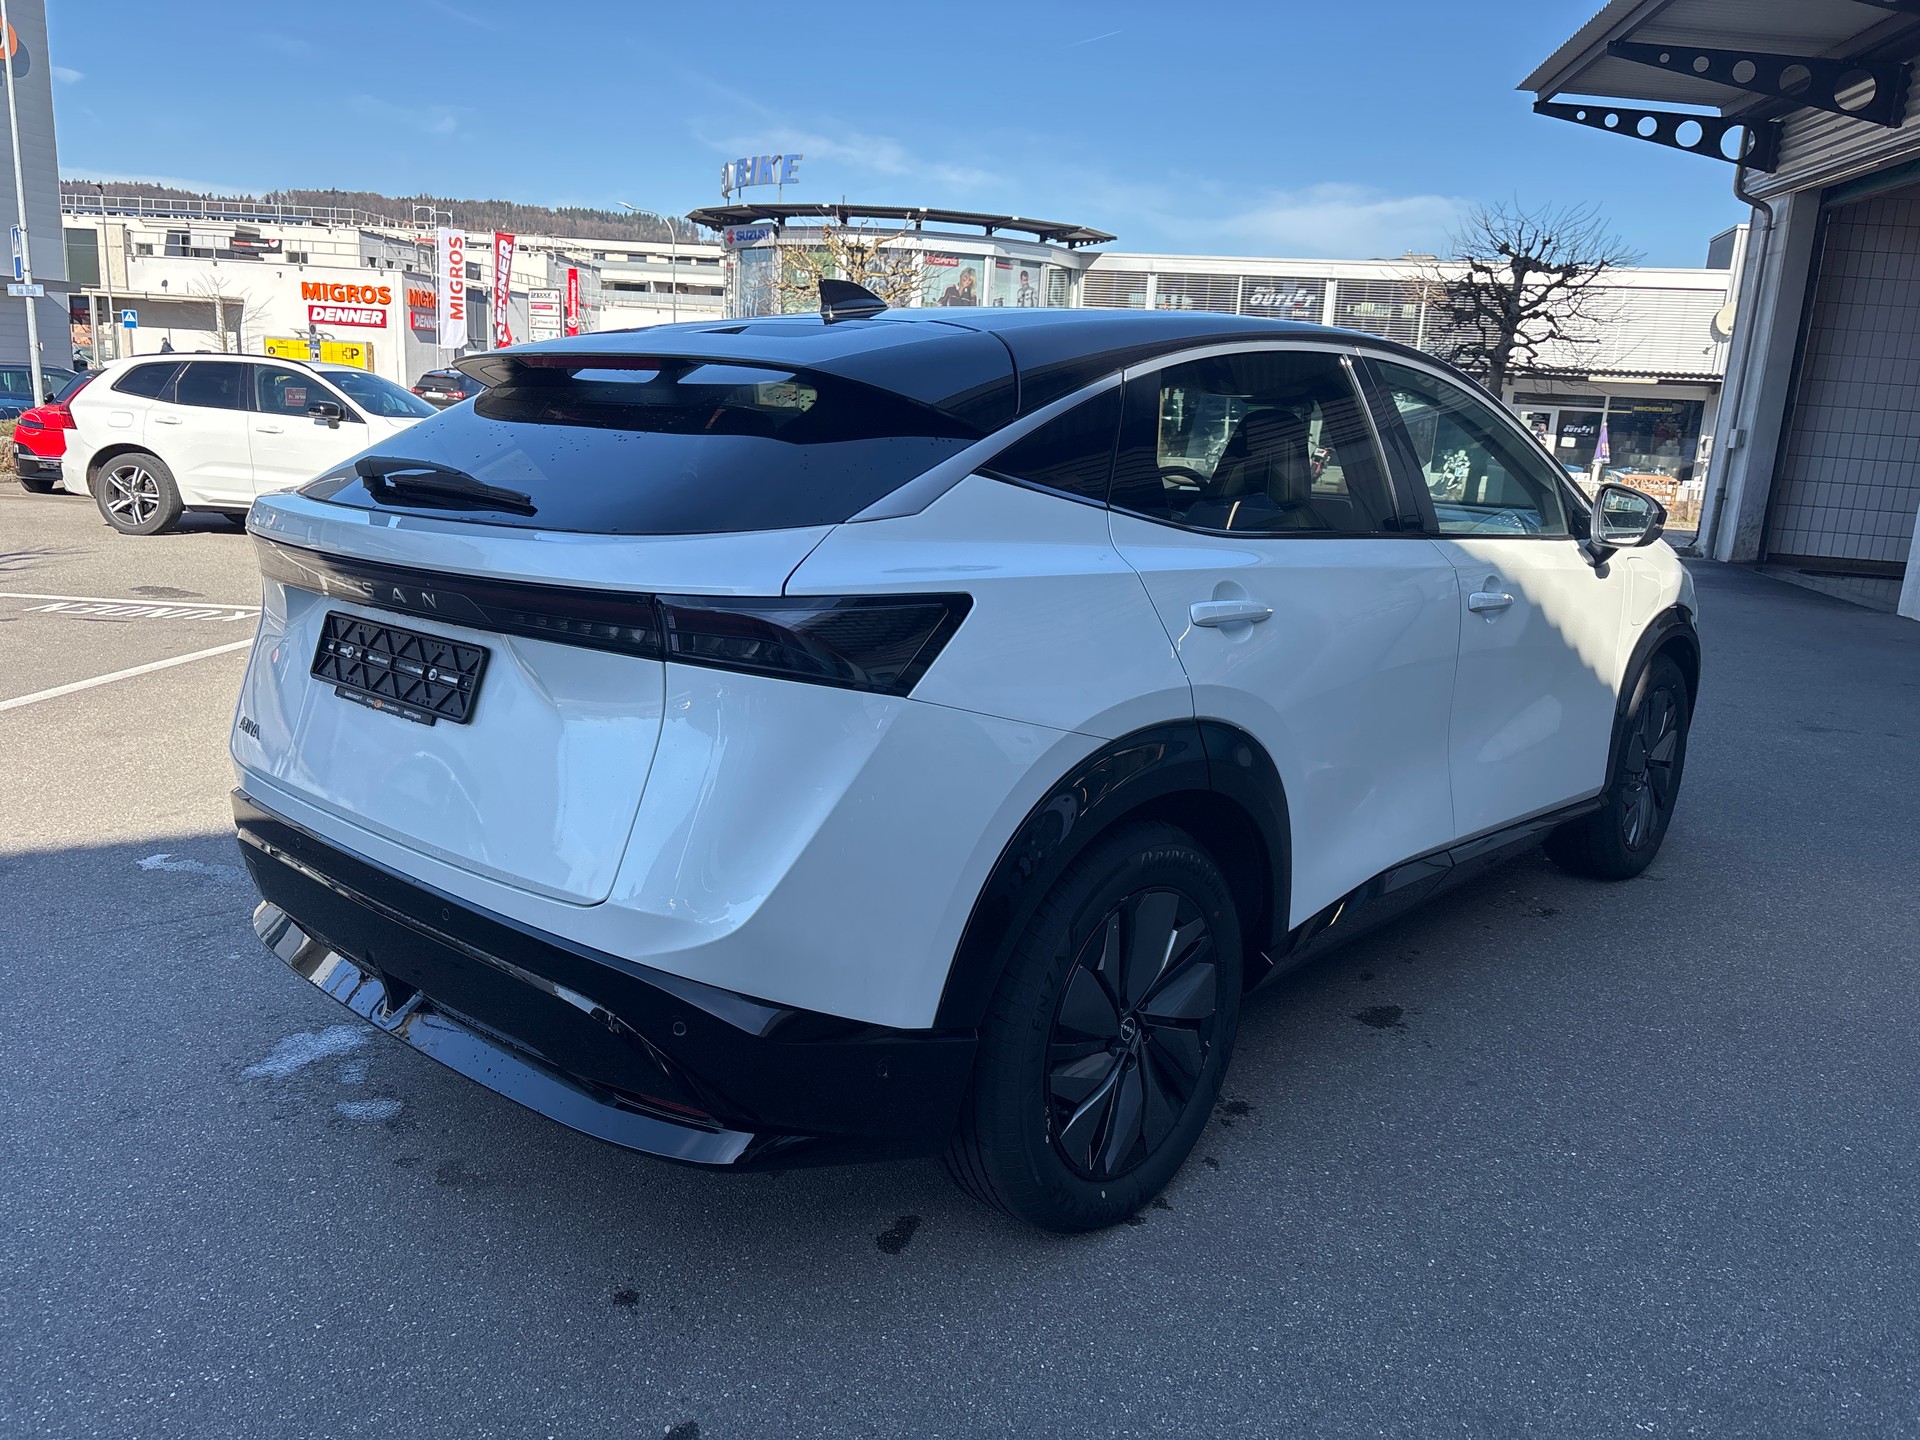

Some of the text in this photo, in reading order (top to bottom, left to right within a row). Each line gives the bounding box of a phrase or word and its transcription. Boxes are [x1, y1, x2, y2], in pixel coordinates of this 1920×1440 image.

[735, 154, 803, 188] BIKE
[448, 236, 464, 320] MIGROS
[301, 282, 391, 305] MIGROS
[407, 288, 436, 309] MIGRO
[497, 239, 512, 343] DENNER
[1250, 289, 1316, 306] OUTLET
[311, 307, 384, 324] DENNER
[414, 314, 436, 328] DENN
[1563, 425, 1590, 433] OUTLET
[22, 602, 262, 622] KUNDEN
